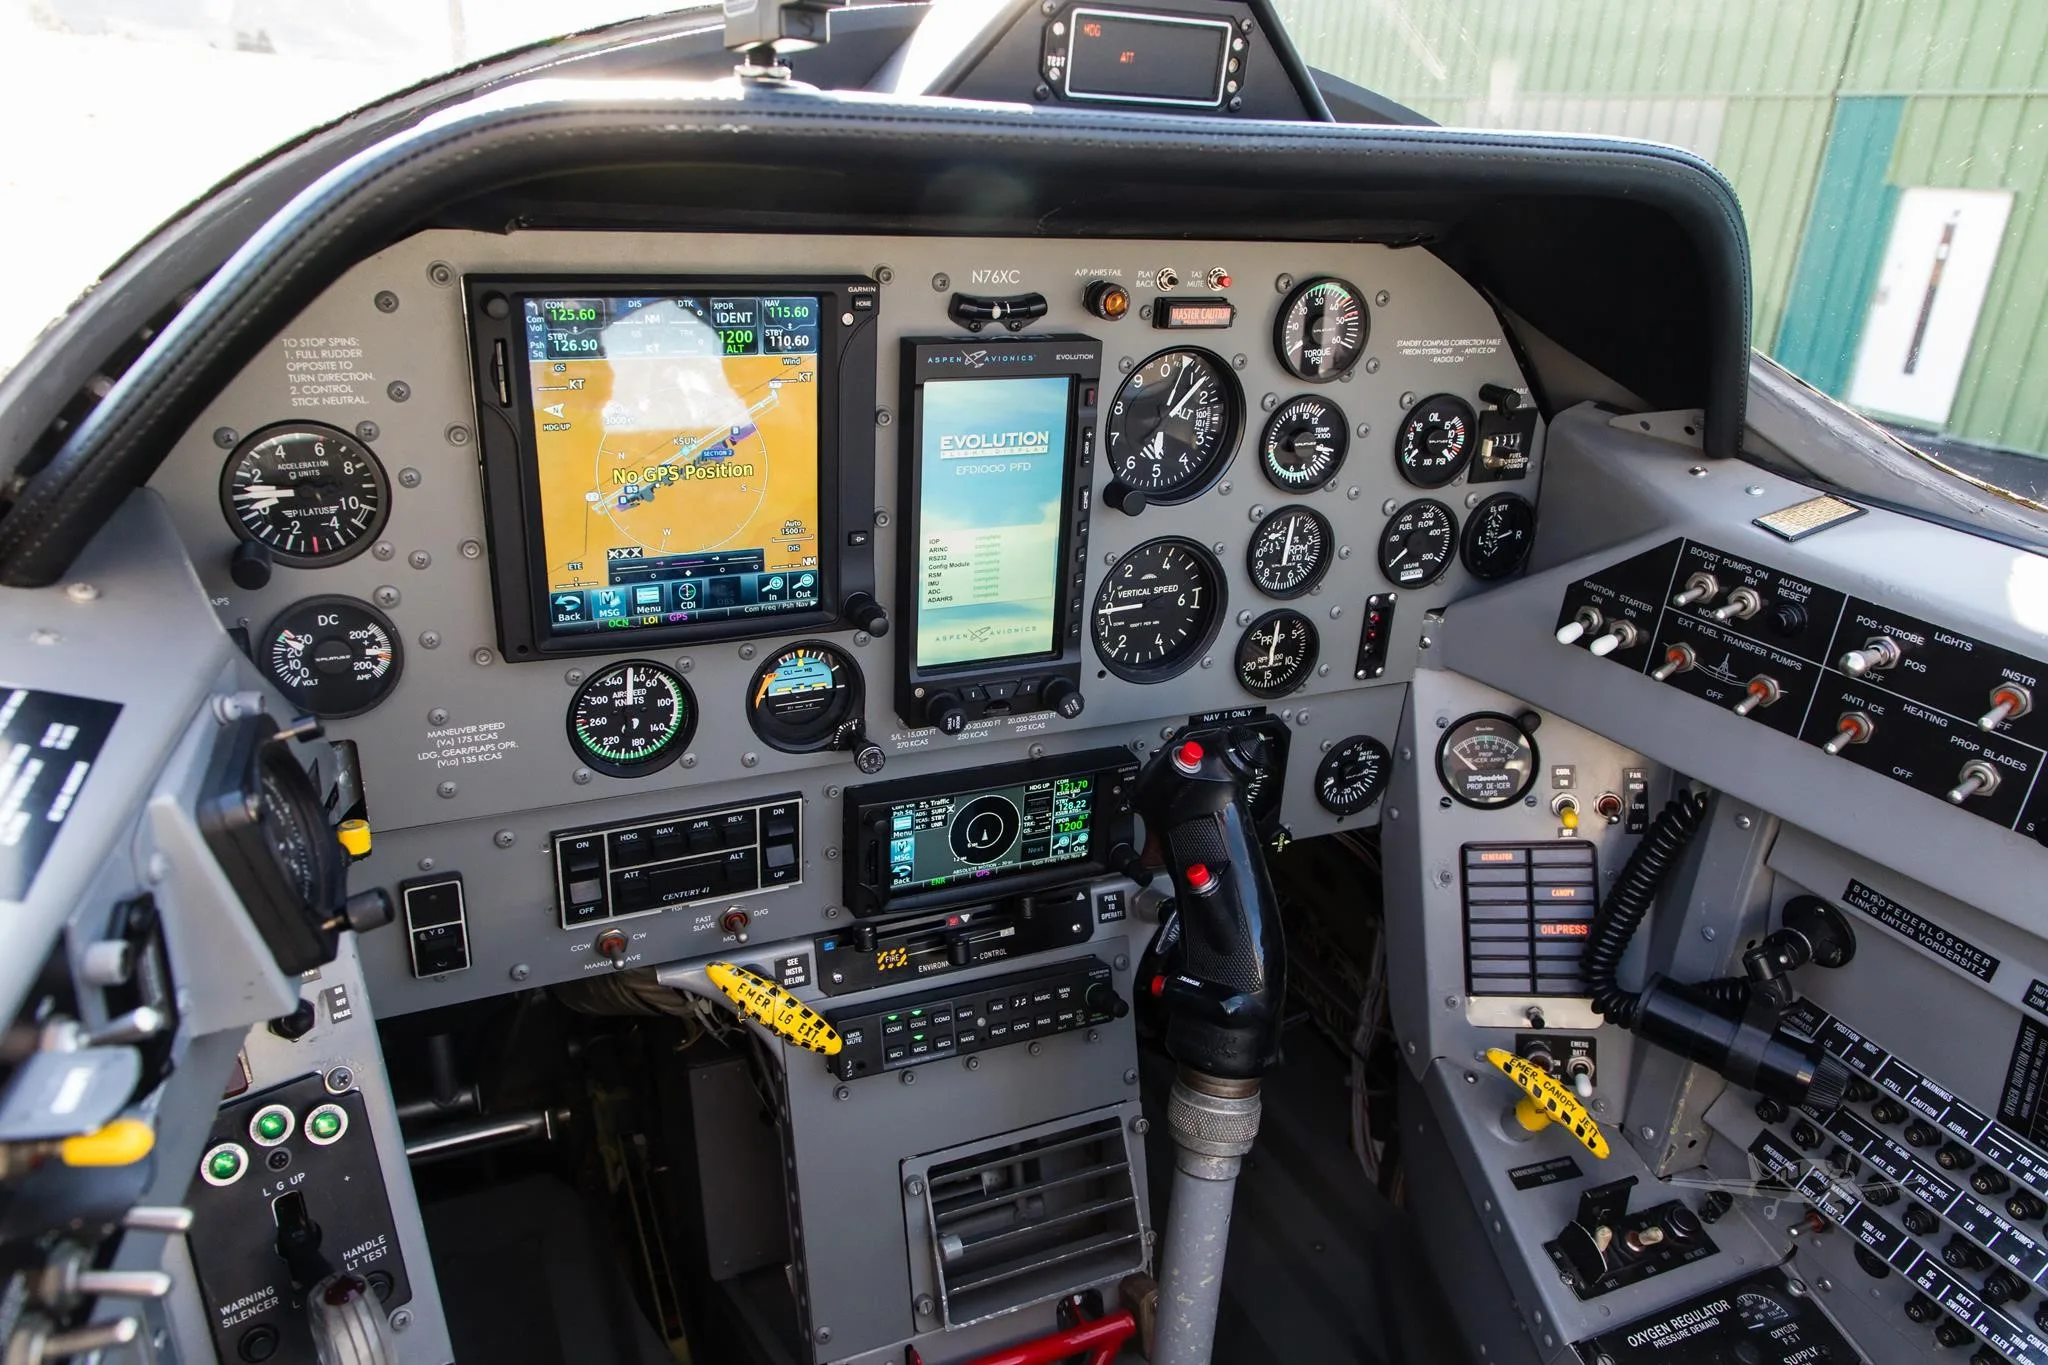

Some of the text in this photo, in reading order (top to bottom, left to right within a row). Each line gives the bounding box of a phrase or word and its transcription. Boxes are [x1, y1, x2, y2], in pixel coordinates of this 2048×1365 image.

[1048, 56, 1065, 67] TEST
[972, 270, 1020, 283] N76XC
[552, 310, 595, 320] 125.60
[770, 307, 808, 317] 115.60
[1172, 308, 1231, 319] MASTER CAUTION
[716, 313, 752, 323] IDENT
[283, 338, 359, 347] TO STOP SPINS:
[719, 331, 752, 343] 1200
[770, 336, 809, 346] 110.60
[553, 340, 597, 351] 126.90
[727, 344, 744, 353] ALT
[285, 350, 362, 359] 1. FULL RUDDER
[1305, 348, 1330, 357] TORQUE
[287, 362, 352, 370] OPPOSITE TO
[288, 373, 375, 383] TURN DIRECTION.
[303, 385, 353, 394] CONTROL
[292, 396, 369, 406] STICK NEUTRAL.
[1429, 413, 1439, 421] OIL
[940, 431, 1048, 450] EVOLUTION
[278, 461, 329, 470] ACCELERATION
[613, 464, 753, 484] No GPS Position
[292, 507, 329, 516] PILATUS
[1690, 547, 1769, 579] BOOST PUMPS ON
[1118, 585, 1178, 598] VERTICAL SPEED
[1584, 580, 1615, 597] IGNITION
[1778, 578, 1812, 595] AUTOM
[1777, 587, 1808, 604] RESET
[637, 605, 661, 613] Menu
[1620, 594, 1653, 613] STARTER
[558, 613, 580, 622] Back
[600, 609, 619, 617] MSG
[670, 613, 688, 621] GPS
[318, 615, 339, 626] DC
[1856, 615, 1925, 645] POS+STROBE
[1677, 618, 1802, 671] EXT FUEL TRANSFER PUMPS
[1934, 632, 1973, 651] LIGHTS
[1904, 659, 1927, 673] POS
[2002, 668, 2036, 686] INSTR
[1706, 689, 1724, 700] OFF
[1841, 693, 1885, 715] ANTI ICE
[1903, 704, 1948, 728] HEATING
[428, 722, 505, 738] MANEUVER SPEED
[418, 740, 518, 760] LDG. GEAR/FLAPS OPR.
[1950, 736, 2027, 771] PROP BLADES
[1893, 766, 1913, 779] OFF
[1060, 781, 1088, 792] 121.70
[931, 798, 949, 806] Traffic
[1059, 801, 1086, 810] 128.22
[693, 821, 709, 829] APR
[656, 827, 673, 835] NAV
[893, 829, 912, 837] Menu
[620, 833, 638, 841] HDG
[1482, 853, 1513, 861] GENERATOR
[1103, 894, 1117, 902] PULL
[579, 906, 594, 914] OFF
[1101, 910, 1123, 920] OPERATE
[695, 916, 712, 924] FAST
[693, 922, 715, 931] SLAVE
[1849, 894, 1986, 977] LINKS UNTER VORDERSITZ
[885, 954, 899, 962] FIRE
[980, 949, 1007, 960] CONTROL
[787, 958, 798, 966] SEE
[785, 967, 802, 976] INSTR
[784, 976, 805, 985] BELOW
[1014, 1022, 1030, 1030] COPLT
[798, 1022, 818, 1044] EXT.
[1834, 1022, 1879, 1055] POSITION INDIC
[1883, 1078, 1901, 1094] STALL
[1921, 1079, 1954, 1102] WARNINGS
[1509, 1058, 1599, 1139] EMER. CANOPY JETT
[1910, 1097, 1938, 1117] CAUTION
[1947, 1121, 1967, 1139] AURAL
[1862, 1220, 1887, 1241] VOR/ILS
[342, 1235, 386, 1260] HANDLE
[347, 1246, 388, 1272] LT TEST
[220, 1286, 275, 1315] WARNING
[1956, 1292, 1974, 1309] BATT
[222, 1297, 279, 1328] SILENCER
[1946, 1299, 1971, 1320] SWITCH
[1627, 1299, 1731, 1348] OXYGEN REGULATOR
[1653, 1317, 1720, 1349] PRESSURE DEMAND
[1770, 1322, 1799, 1339] OXYGEN
[2009, 1333, 2029, 1350] TRIM
[1783, 1346, 1819, 1365] SUPPLY
